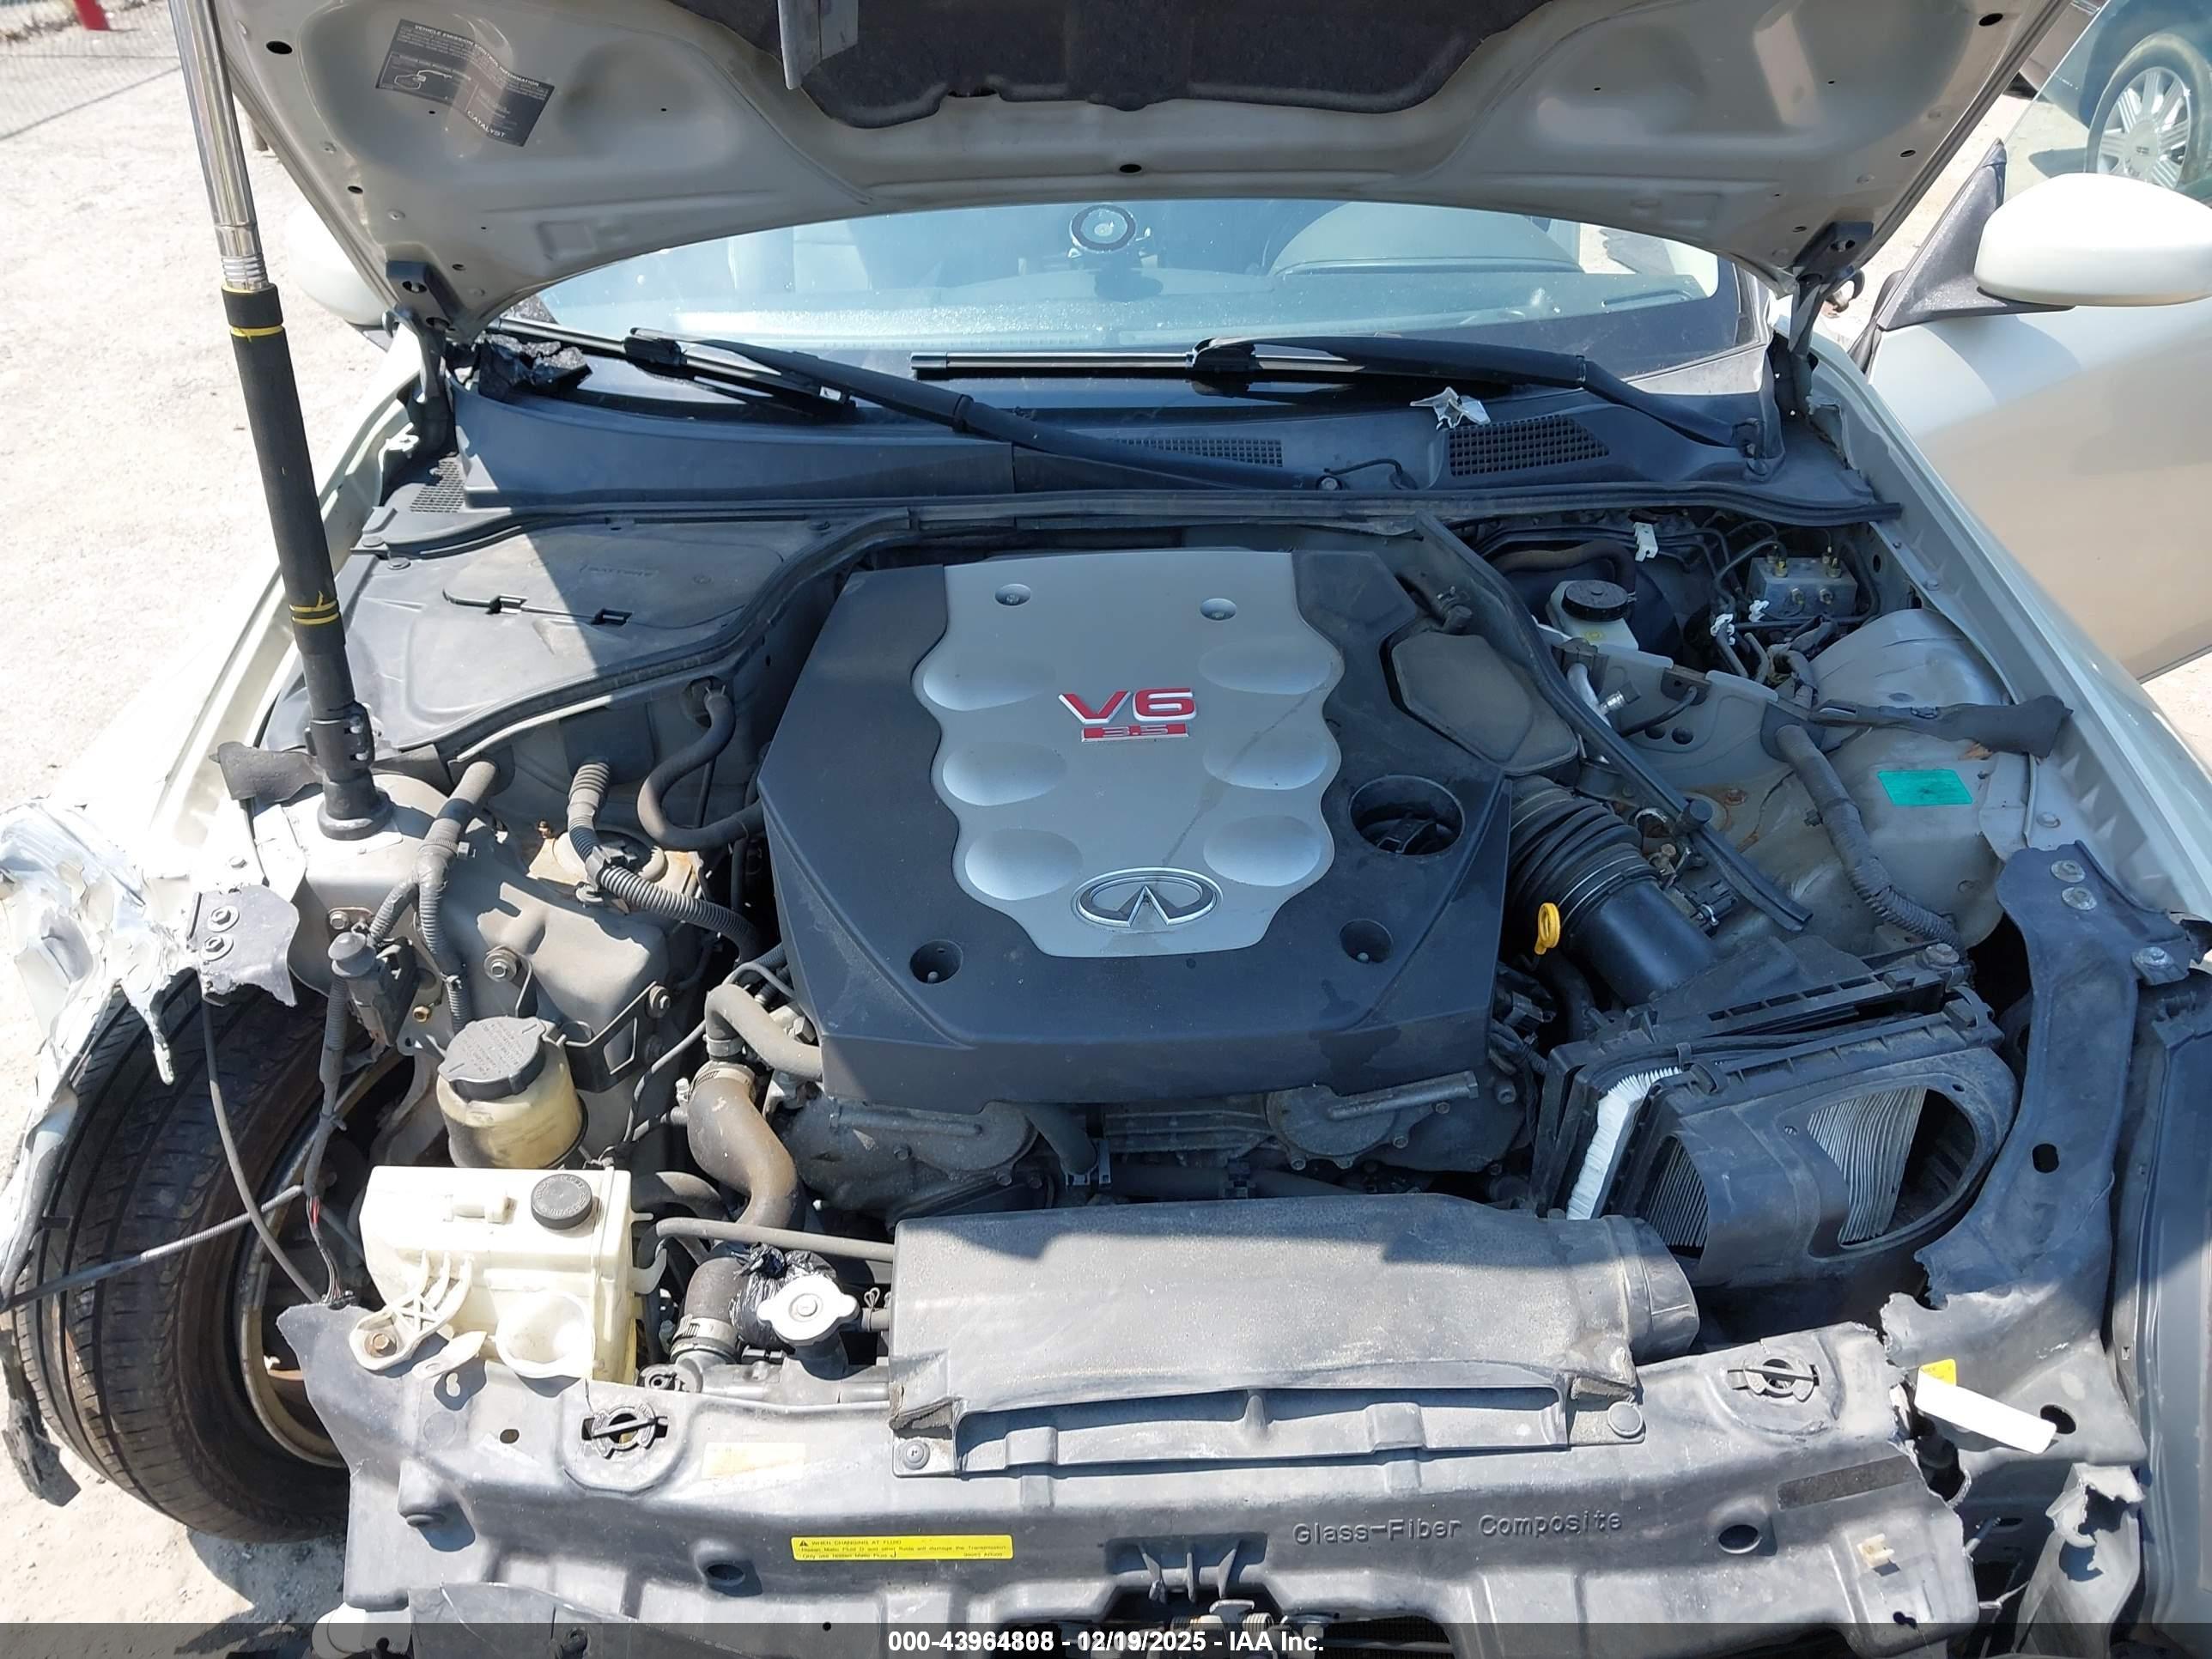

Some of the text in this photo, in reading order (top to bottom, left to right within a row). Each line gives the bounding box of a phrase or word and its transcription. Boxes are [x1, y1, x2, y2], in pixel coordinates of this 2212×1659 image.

[415, 24, 441, 35] VEHICLE
[442, 32, 474, 46] EMISSION
[499, 65, 539, 87] INFORMATION
[467, 110, 506, 137] CATALYST
[1058, 688, 1196, 724] V6
[1291, 1510, 1623, 1545] Glass-Fiber Composite
